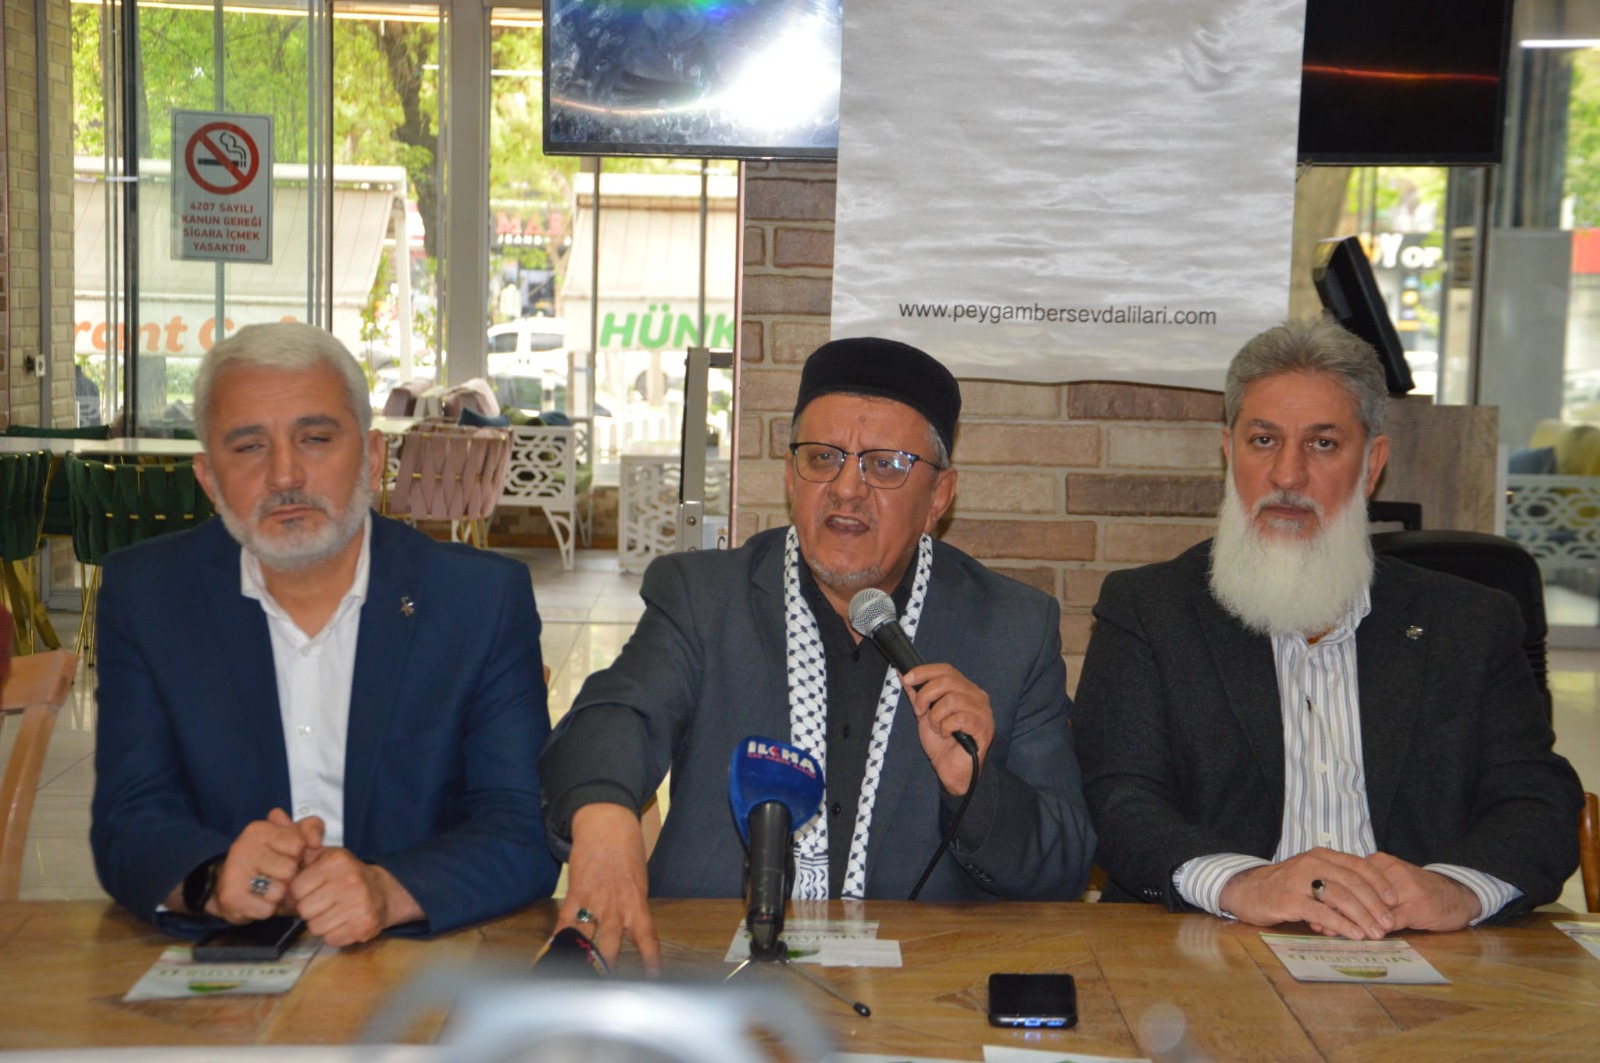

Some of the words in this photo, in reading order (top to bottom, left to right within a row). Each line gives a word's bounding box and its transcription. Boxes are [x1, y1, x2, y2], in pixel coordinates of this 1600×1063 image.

[190, 202, 215, 212] 4207
[219, 203, 253, 213] SAYILI
[182, 215, 219, 224] KANUN
[224, 216, 261, 228] GEREĞİ
[183, 226, 222, 238] SİGARA
[227, 227, 260, 241] İÇMEK
[194, 242, 249, 253] YASAKTIR.
[900, 303, 1216, 325] www.peygambersevdalilari.com
[599, 303, 734, 349] HÜNK
